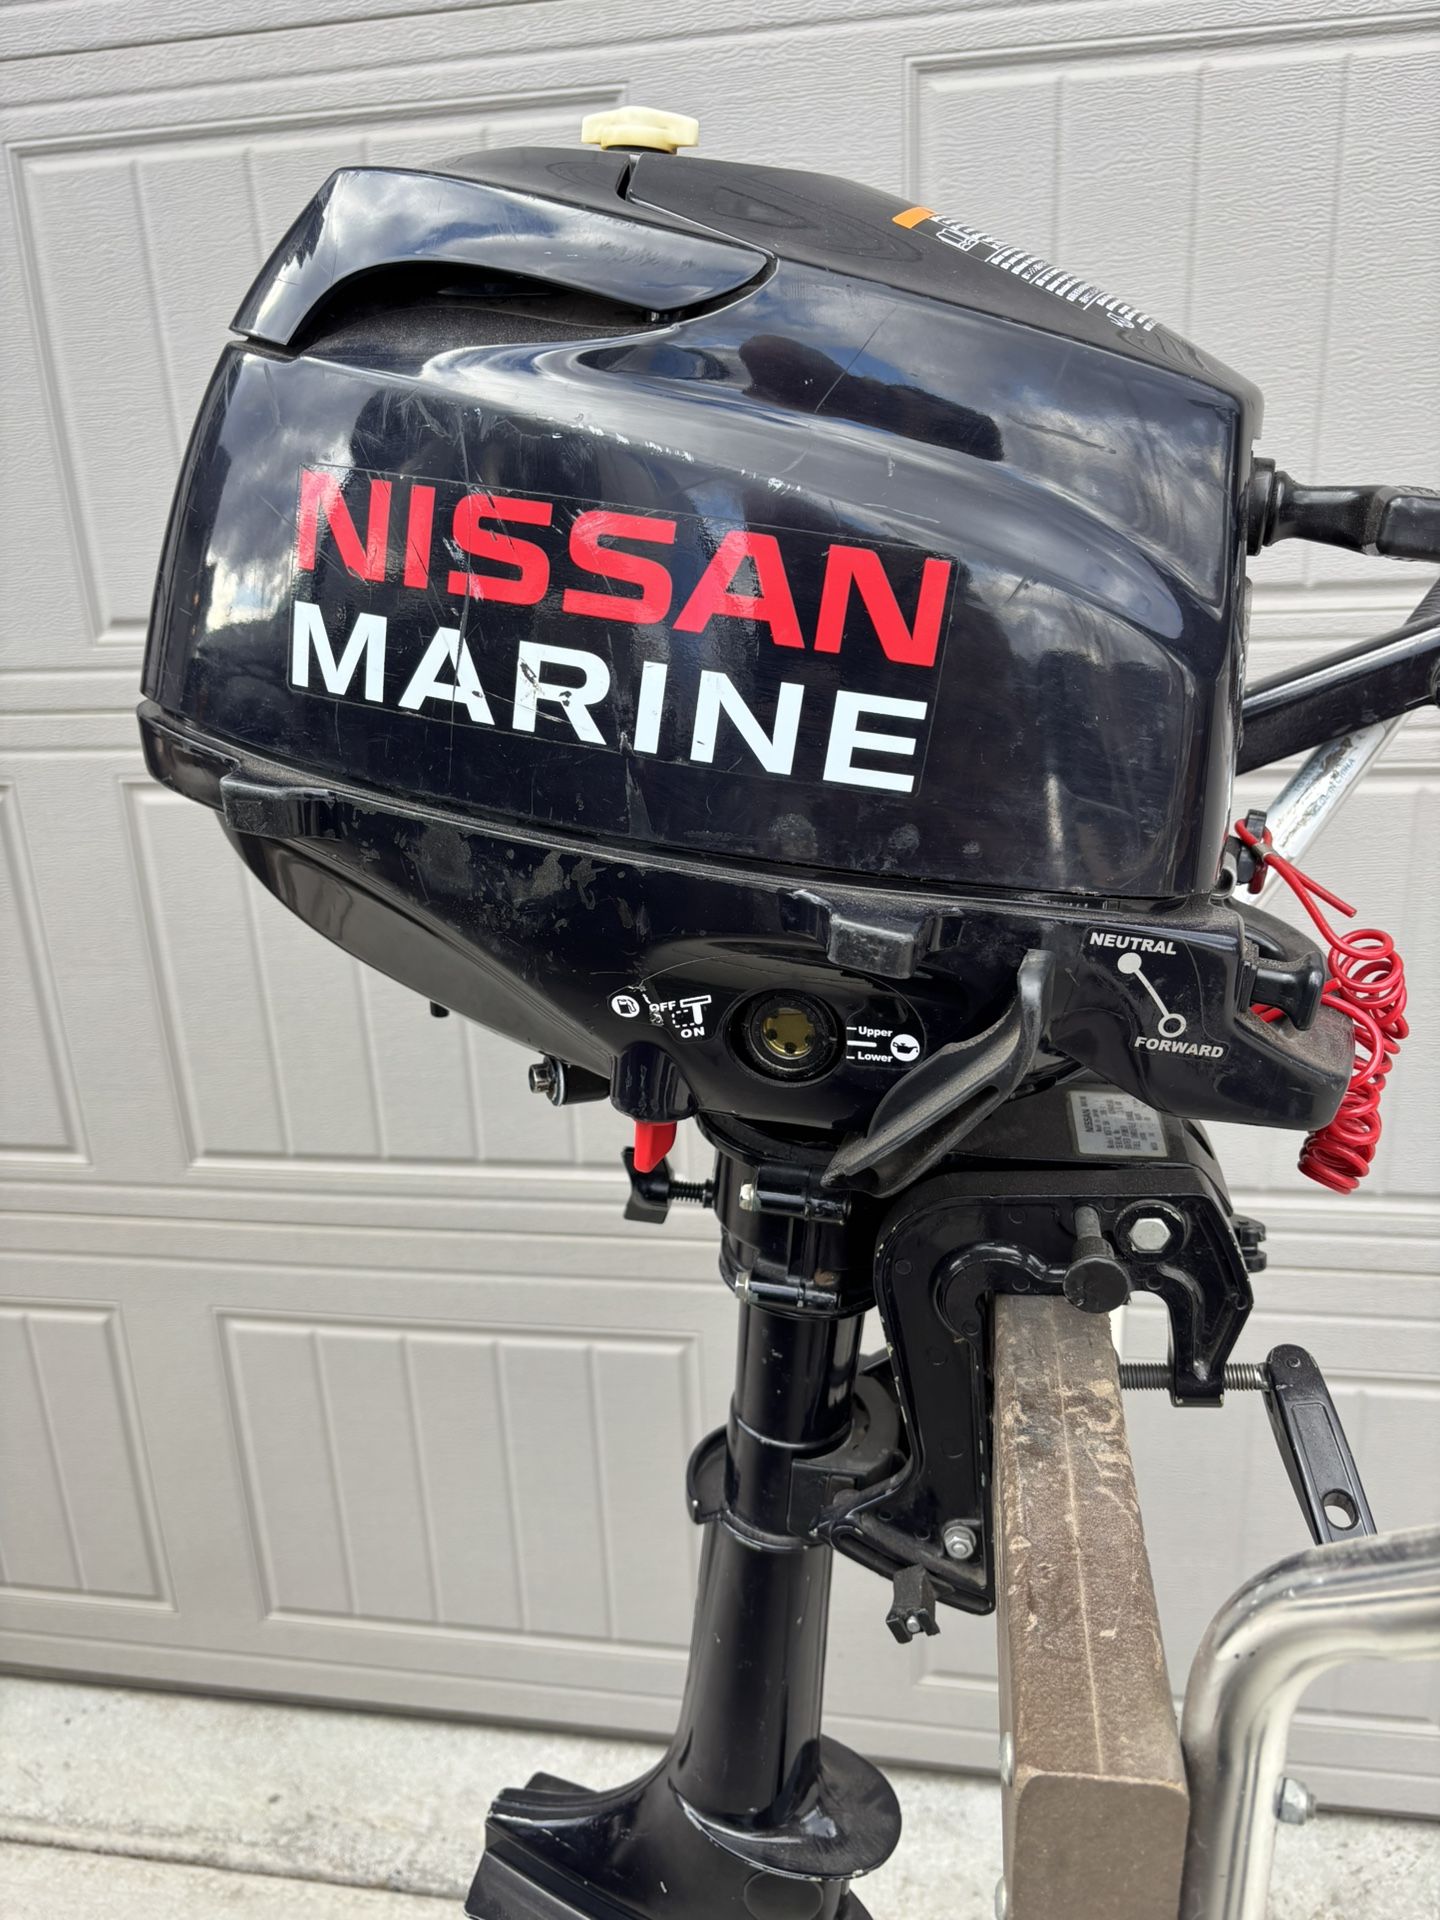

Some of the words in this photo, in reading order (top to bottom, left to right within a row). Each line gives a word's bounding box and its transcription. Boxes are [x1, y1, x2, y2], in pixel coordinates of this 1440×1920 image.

[296, 471, 951, 667] NISSAN
[291, 600, 928, 794] MARINE
[1089, 931, 1177, 956] NEUTRAL
[649, 1000, 677, 1013] OFF
[680, 1025, 706, 1039] ON
[857, 1025, 894, 1040] Upper
[1134, 1035, 1224, 1059] FORWARD
[857, 1050, 894, 1064] Lower
